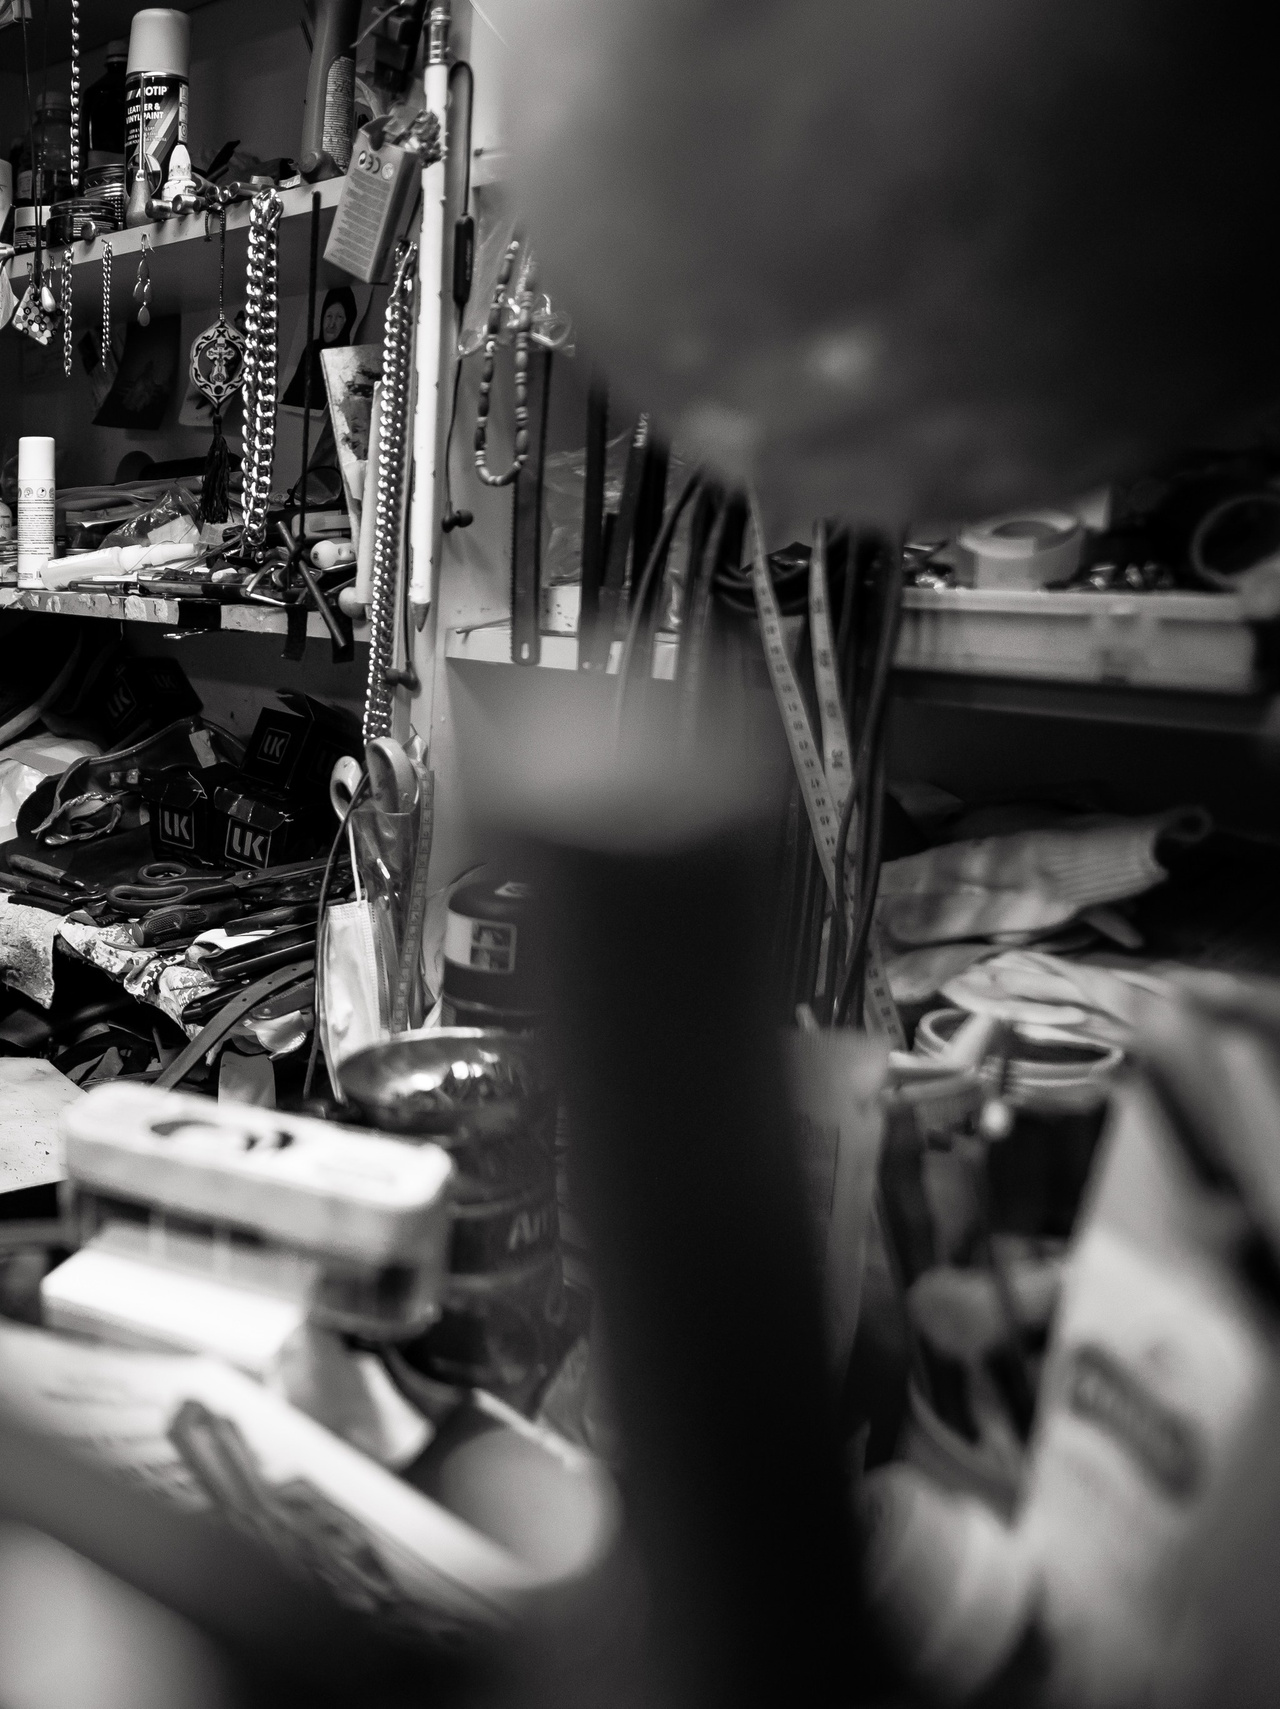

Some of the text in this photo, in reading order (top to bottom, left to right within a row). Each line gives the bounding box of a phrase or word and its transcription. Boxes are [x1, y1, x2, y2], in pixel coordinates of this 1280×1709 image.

[263, 734, 286, 758] LK
[164, 810, 190, 840] LK
[232, 826, 265, 862] LK
